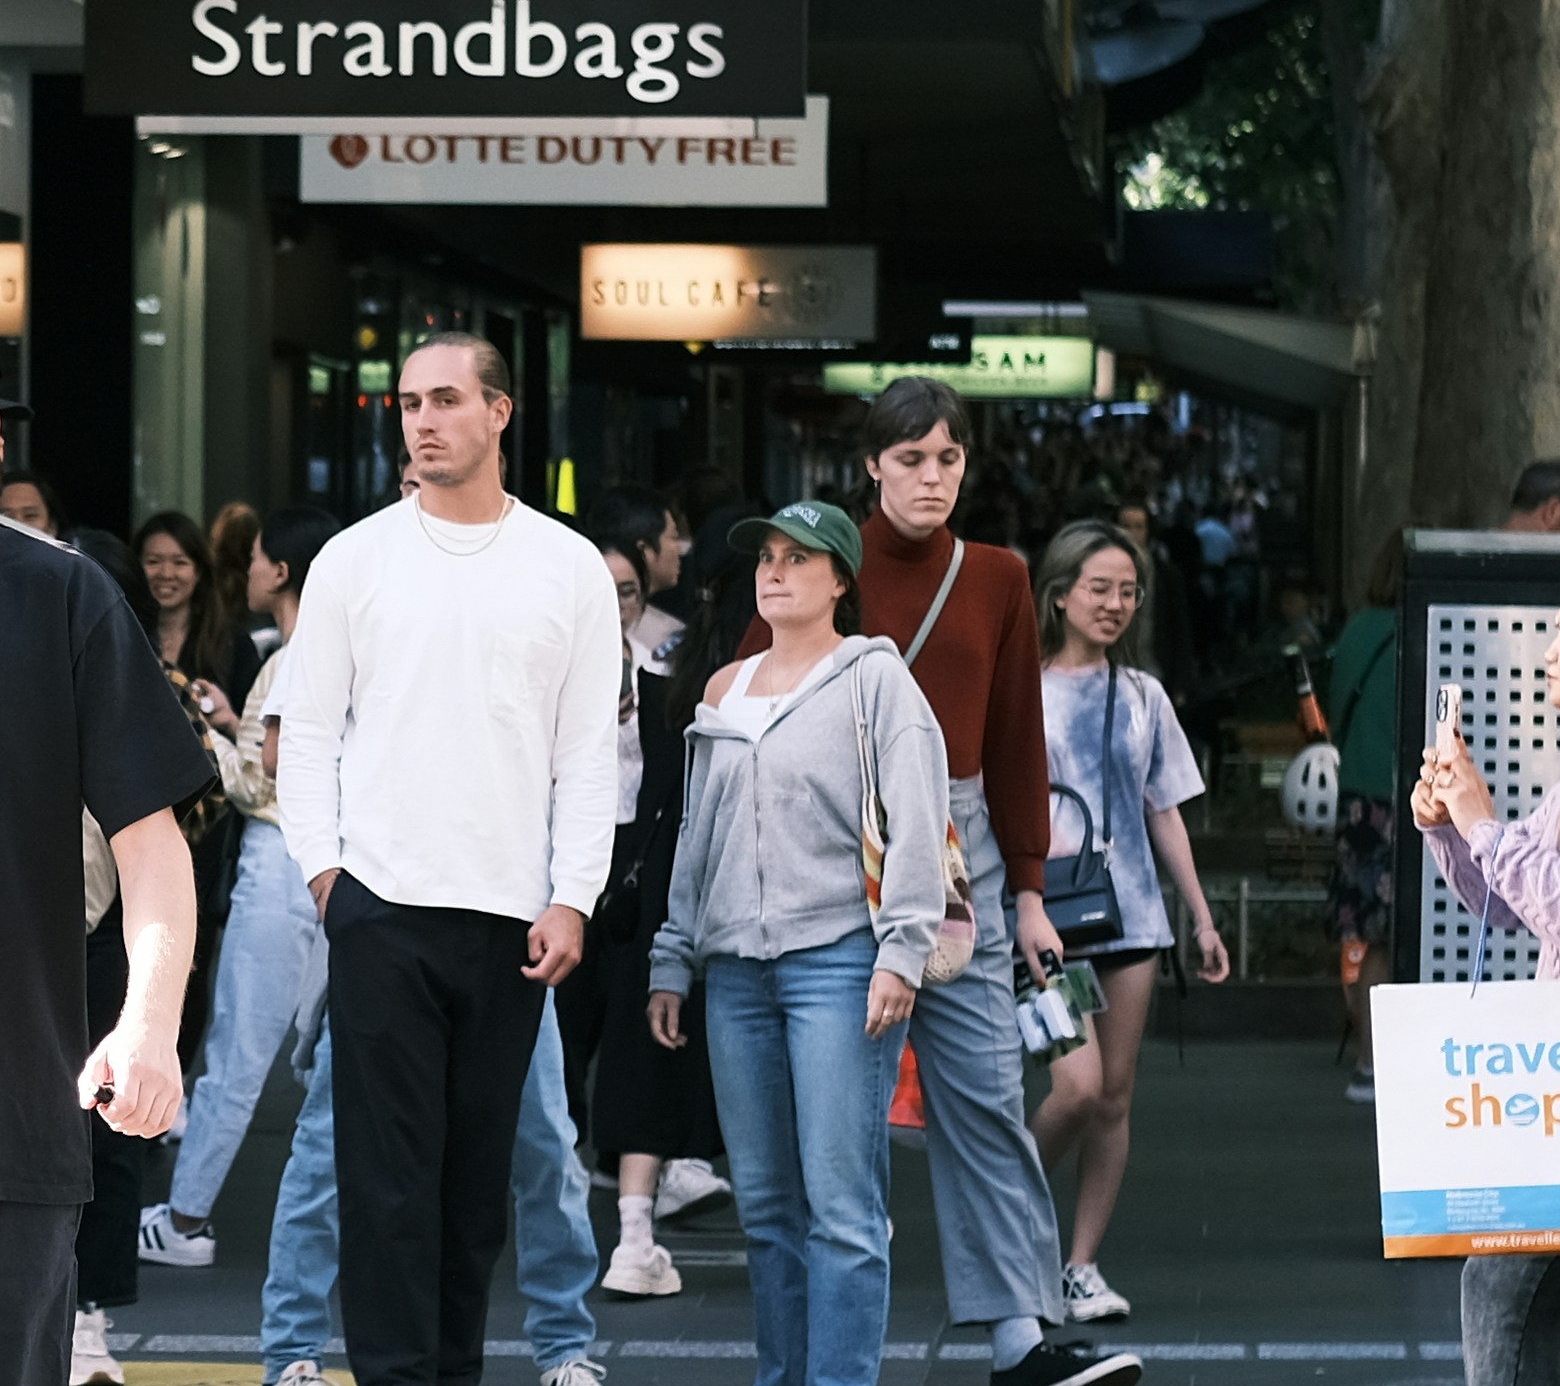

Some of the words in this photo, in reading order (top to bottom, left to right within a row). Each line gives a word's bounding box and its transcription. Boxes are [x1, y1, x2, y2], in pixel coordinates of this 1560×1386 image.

[381, 134, 525, 165] LOTTE
[537, 135, 667, 166] DUTY
[676, 137, 797, 167] FREE
[592, 280, 670, 307] SOUL
